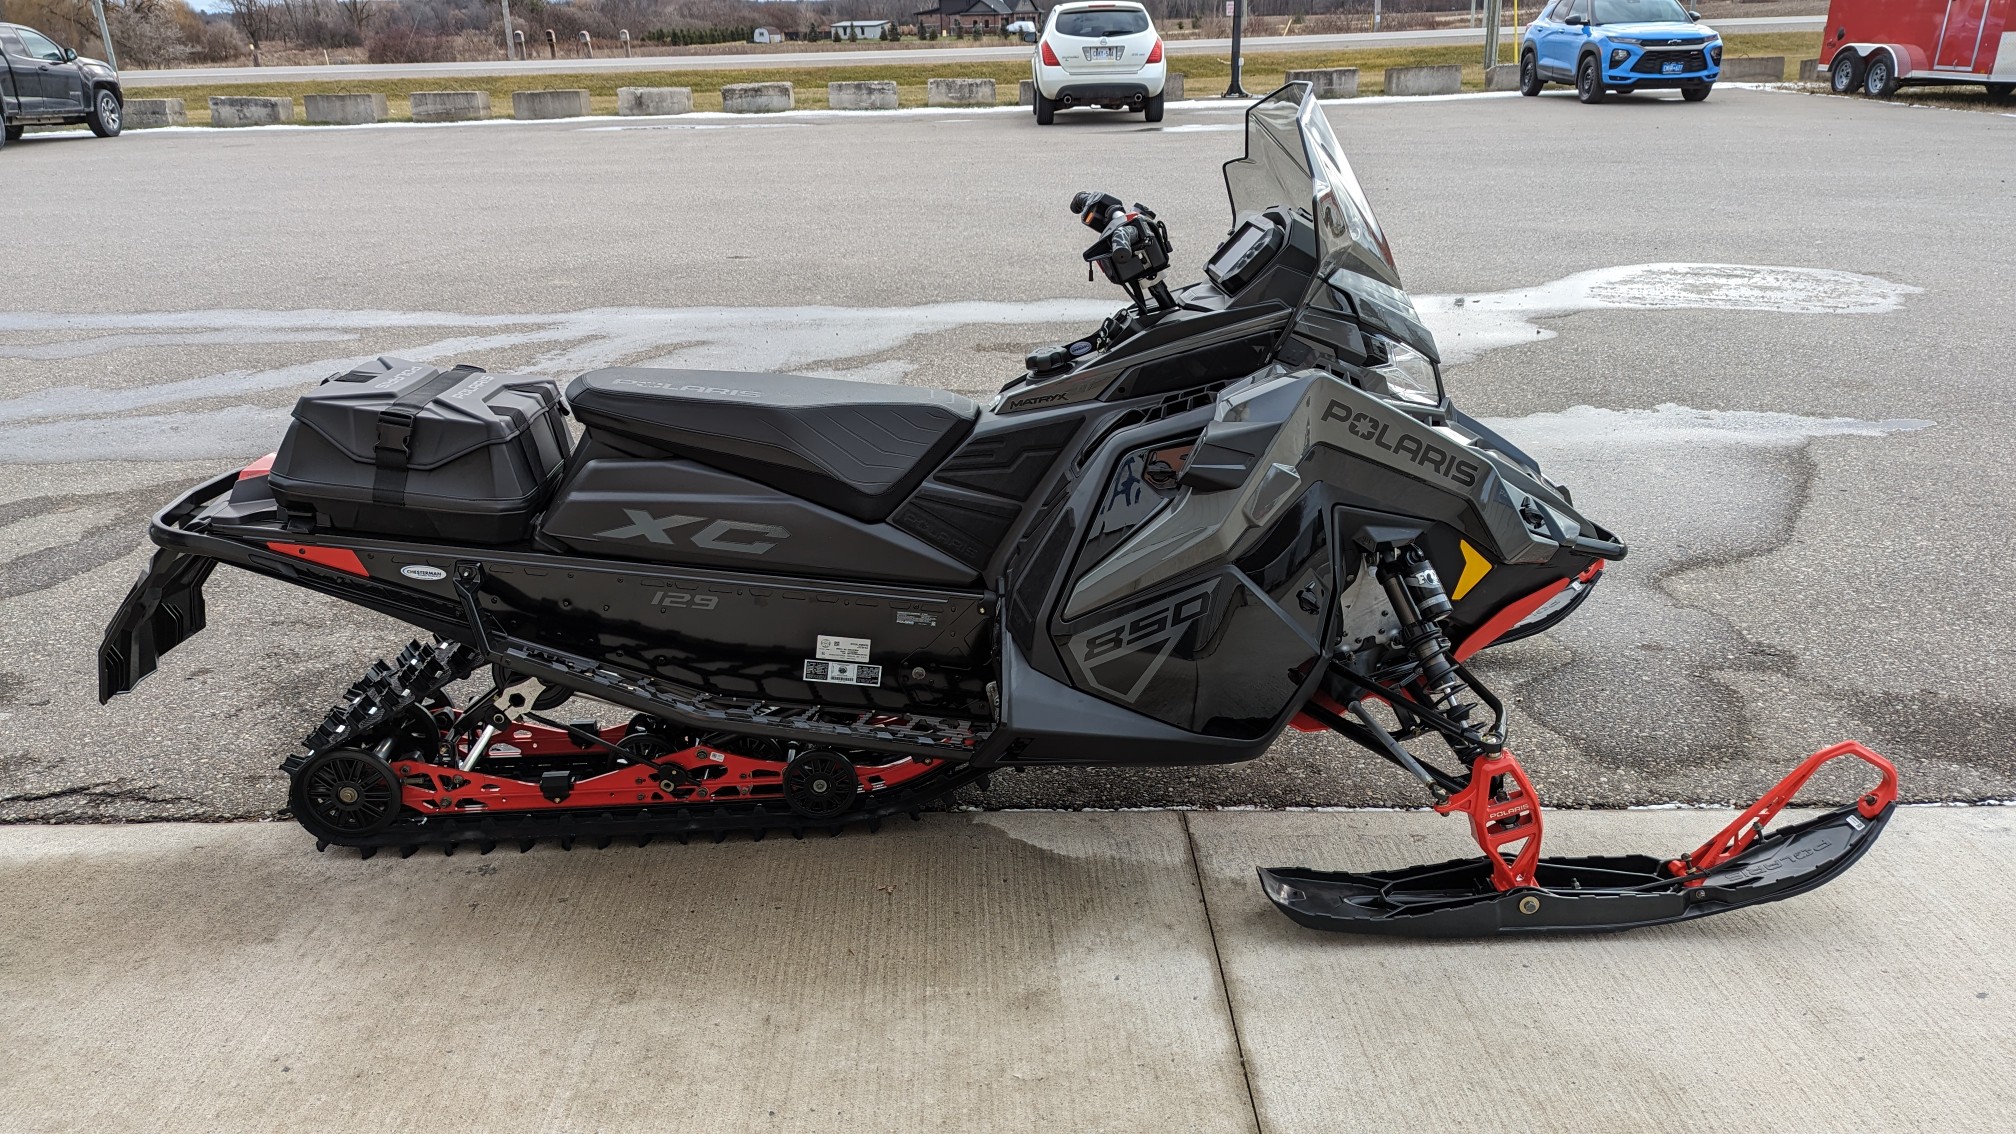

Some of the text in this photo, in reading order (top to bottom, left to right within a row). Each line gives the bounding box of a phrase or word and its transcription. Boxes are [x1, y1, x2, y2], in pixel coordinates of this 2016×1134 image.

[374, 366, 422, 389] POLARIS
[451, 375, 494, 399] POLARIS
[612, 378, 762, 398] POLARIS
[1010, 392, 1069, 410] MATRYX
[1321, 399, 1479, 488] POLARIS
[593, 508, 791, 554] XC
[903, 513, 978, 559] POLARIS
[651, 591, 719, 610] 129
[1084, 591, 1211, 662] 850
[1490, 803, 1529, 819] POLARIS
[1723, 838, 1833, 882] POLARIS
